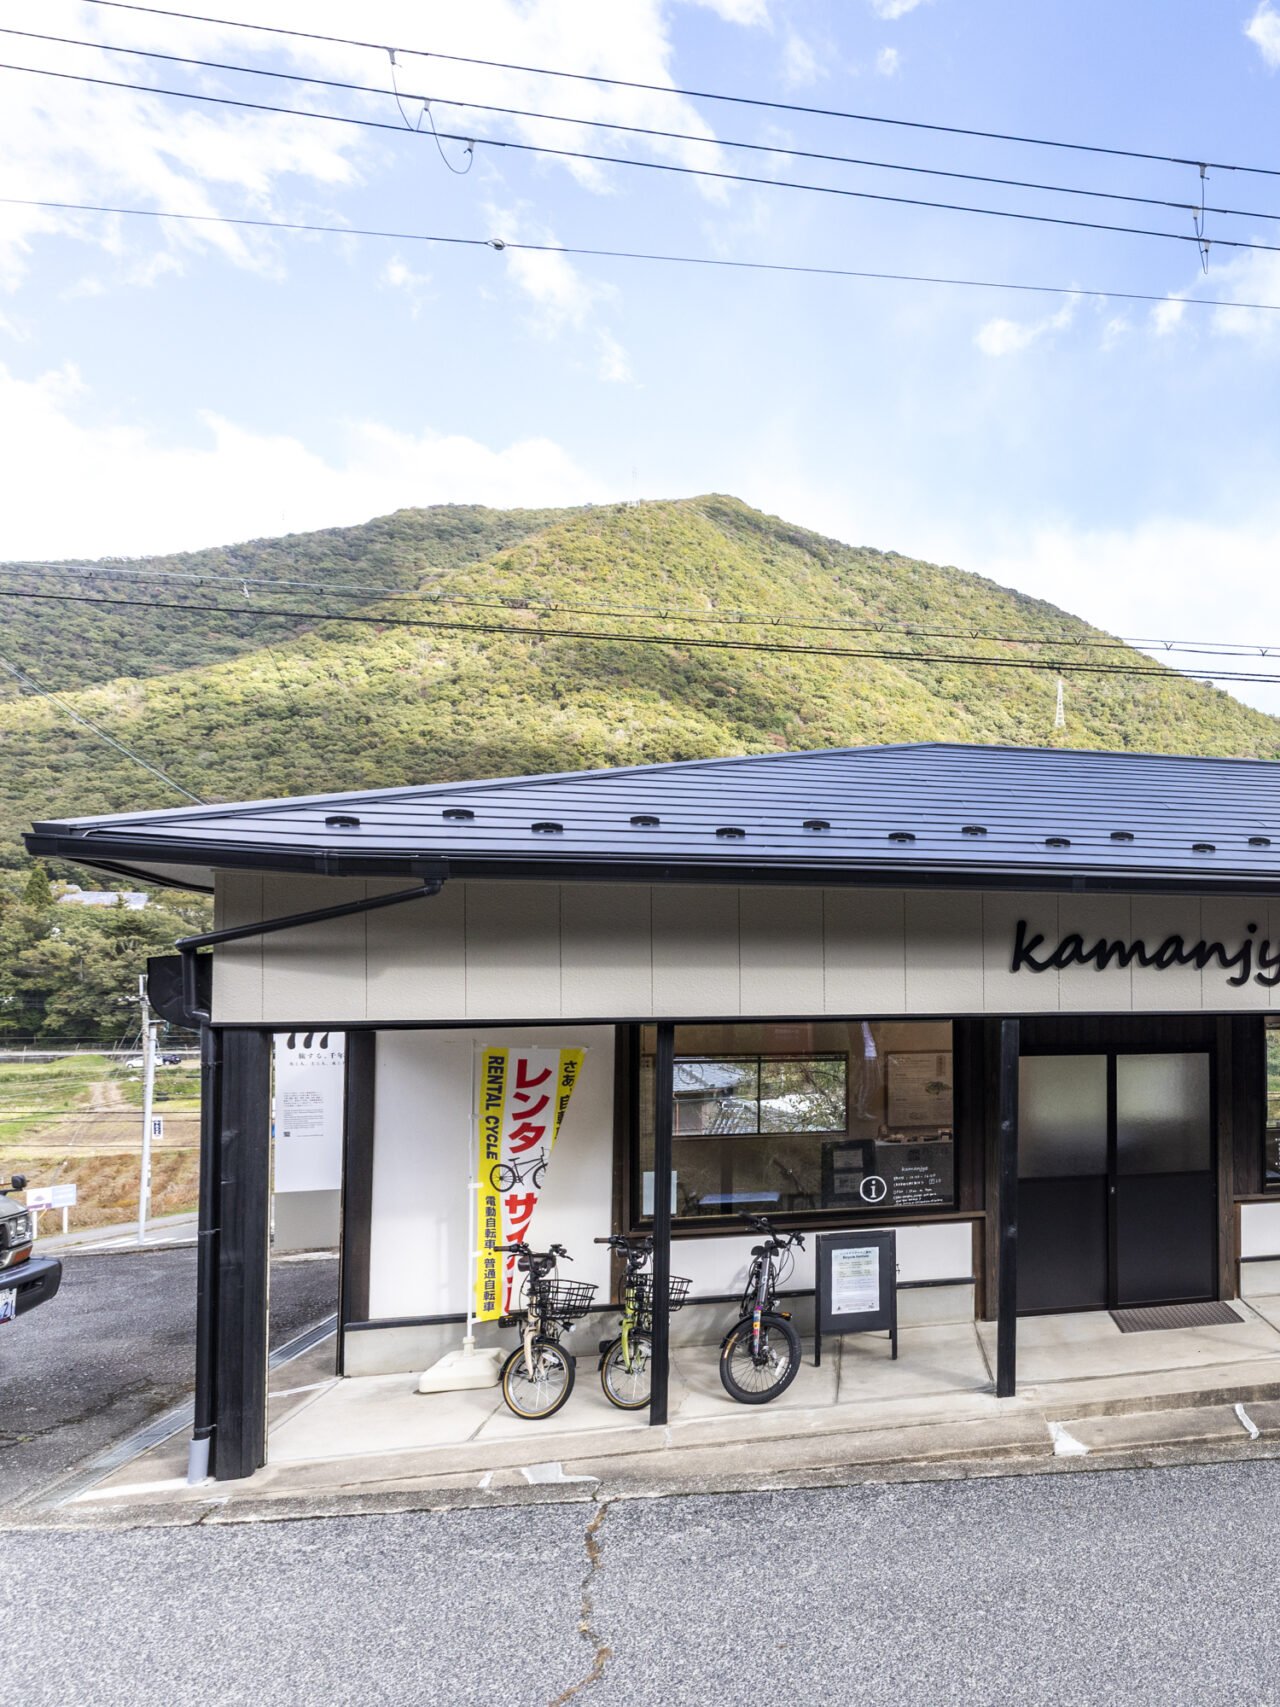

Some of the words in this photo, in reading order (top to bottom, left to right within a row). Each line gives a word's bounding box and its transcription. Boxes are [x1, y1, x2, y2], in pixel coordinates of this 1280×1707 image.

[485, 1055, 505, 1111] RENTAL
[485, 1116, 500, 1160] CYCLE
[483, 1195, 496, 1312] 電動自転車・普通自転車
